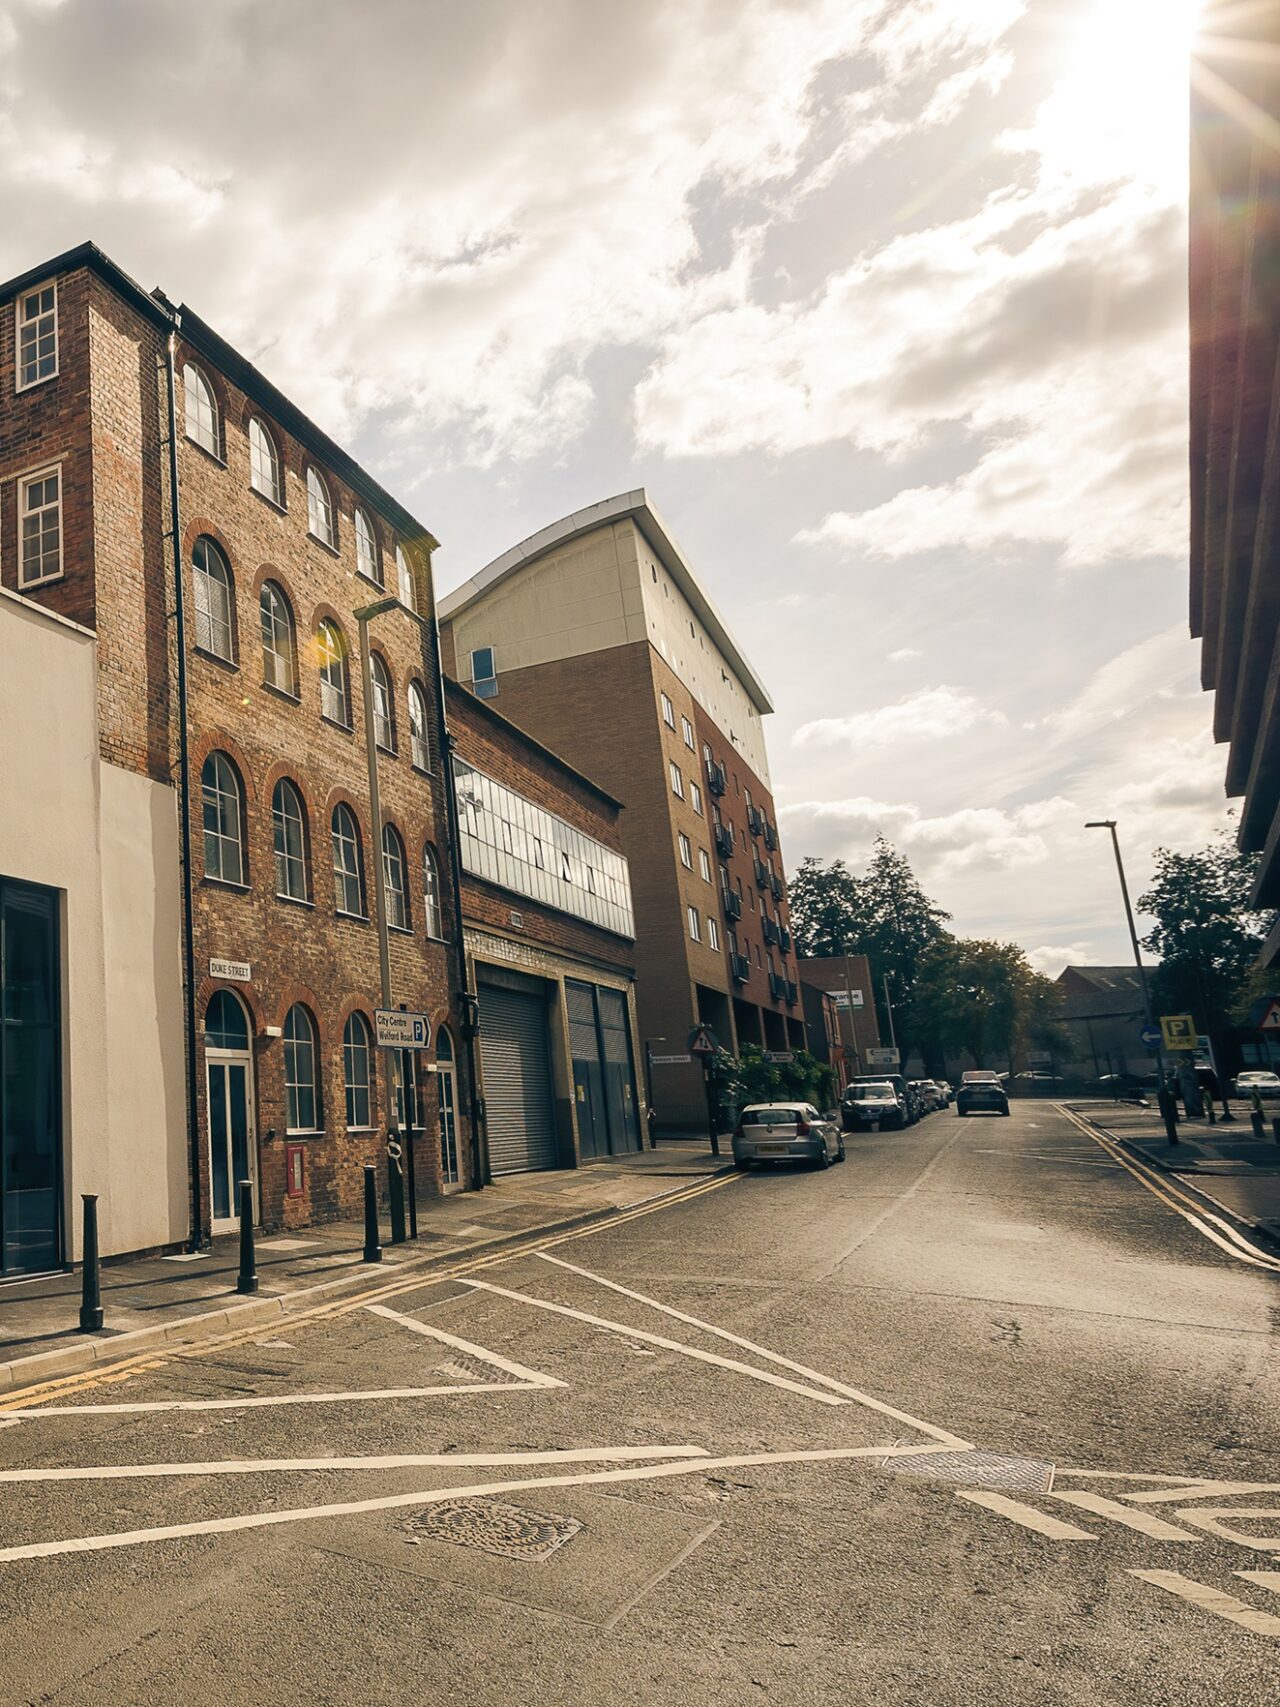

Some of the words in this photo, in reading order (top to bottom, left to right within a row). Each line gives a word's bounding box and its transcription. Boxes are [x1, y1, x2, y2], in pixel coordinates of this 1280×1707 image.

[211, 963, 227, 974] DUKE
[228, 965, 249, 977] STREET
[378, 1015, 388, 1027] City
[389, 1016, 407, 1027] Centre
[379, 1030, 400, 1041] Welford
[400, 1031, 413, 1042] Road
